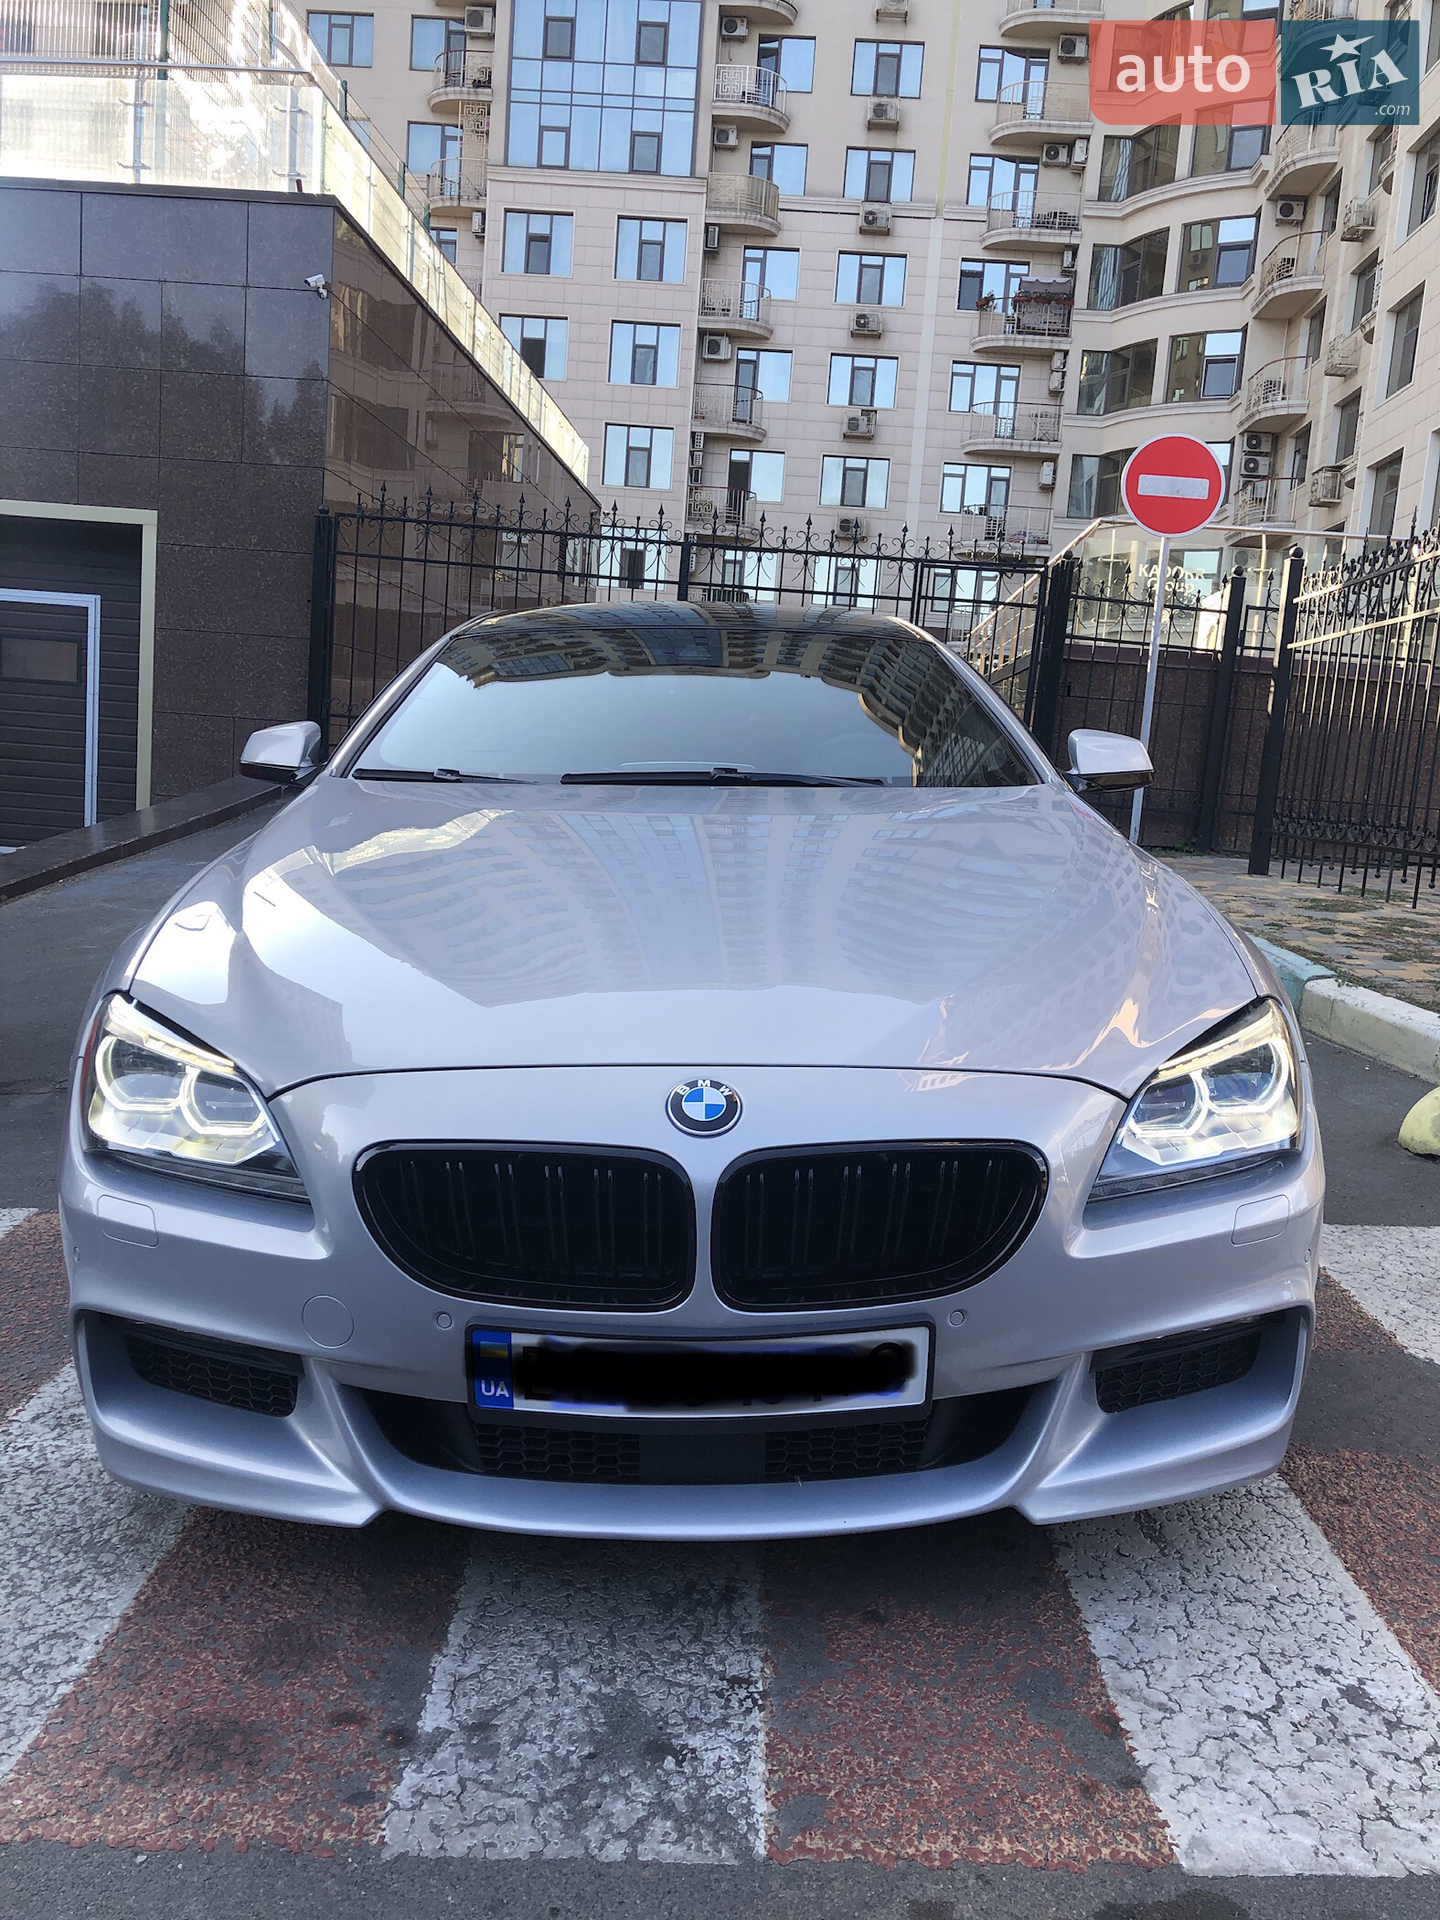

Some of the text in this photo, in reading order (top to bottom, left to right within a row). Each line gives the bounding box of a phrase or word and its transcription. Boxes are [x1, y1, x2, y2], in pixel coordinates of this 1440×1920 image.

[1146, 577, 1195, 598] Goup
[676, 1079, 733, 1096] BMW
[481, 1379, 510, 1398] UA
